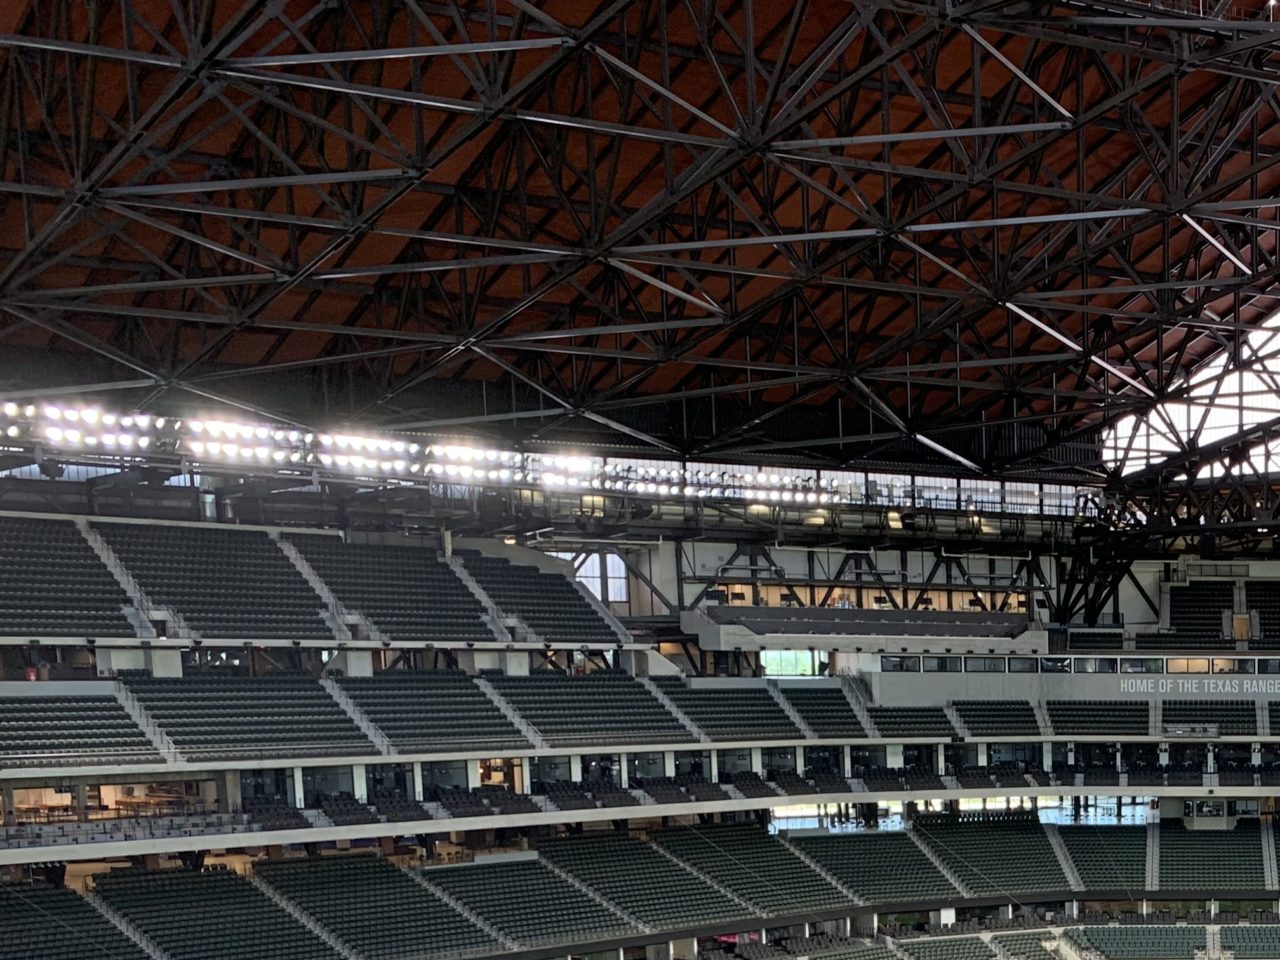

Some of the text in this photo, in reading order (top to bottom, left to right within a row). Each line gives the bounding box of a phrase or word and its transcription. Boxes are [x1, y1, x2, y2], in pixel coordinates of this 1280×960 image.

[1120, 679, 1155, 693] HOME
[1159, 679, 1174, 693] OF
[1177, 679, 1199, 693] THE
[1203, 679, 1239, 693] TEXAS
